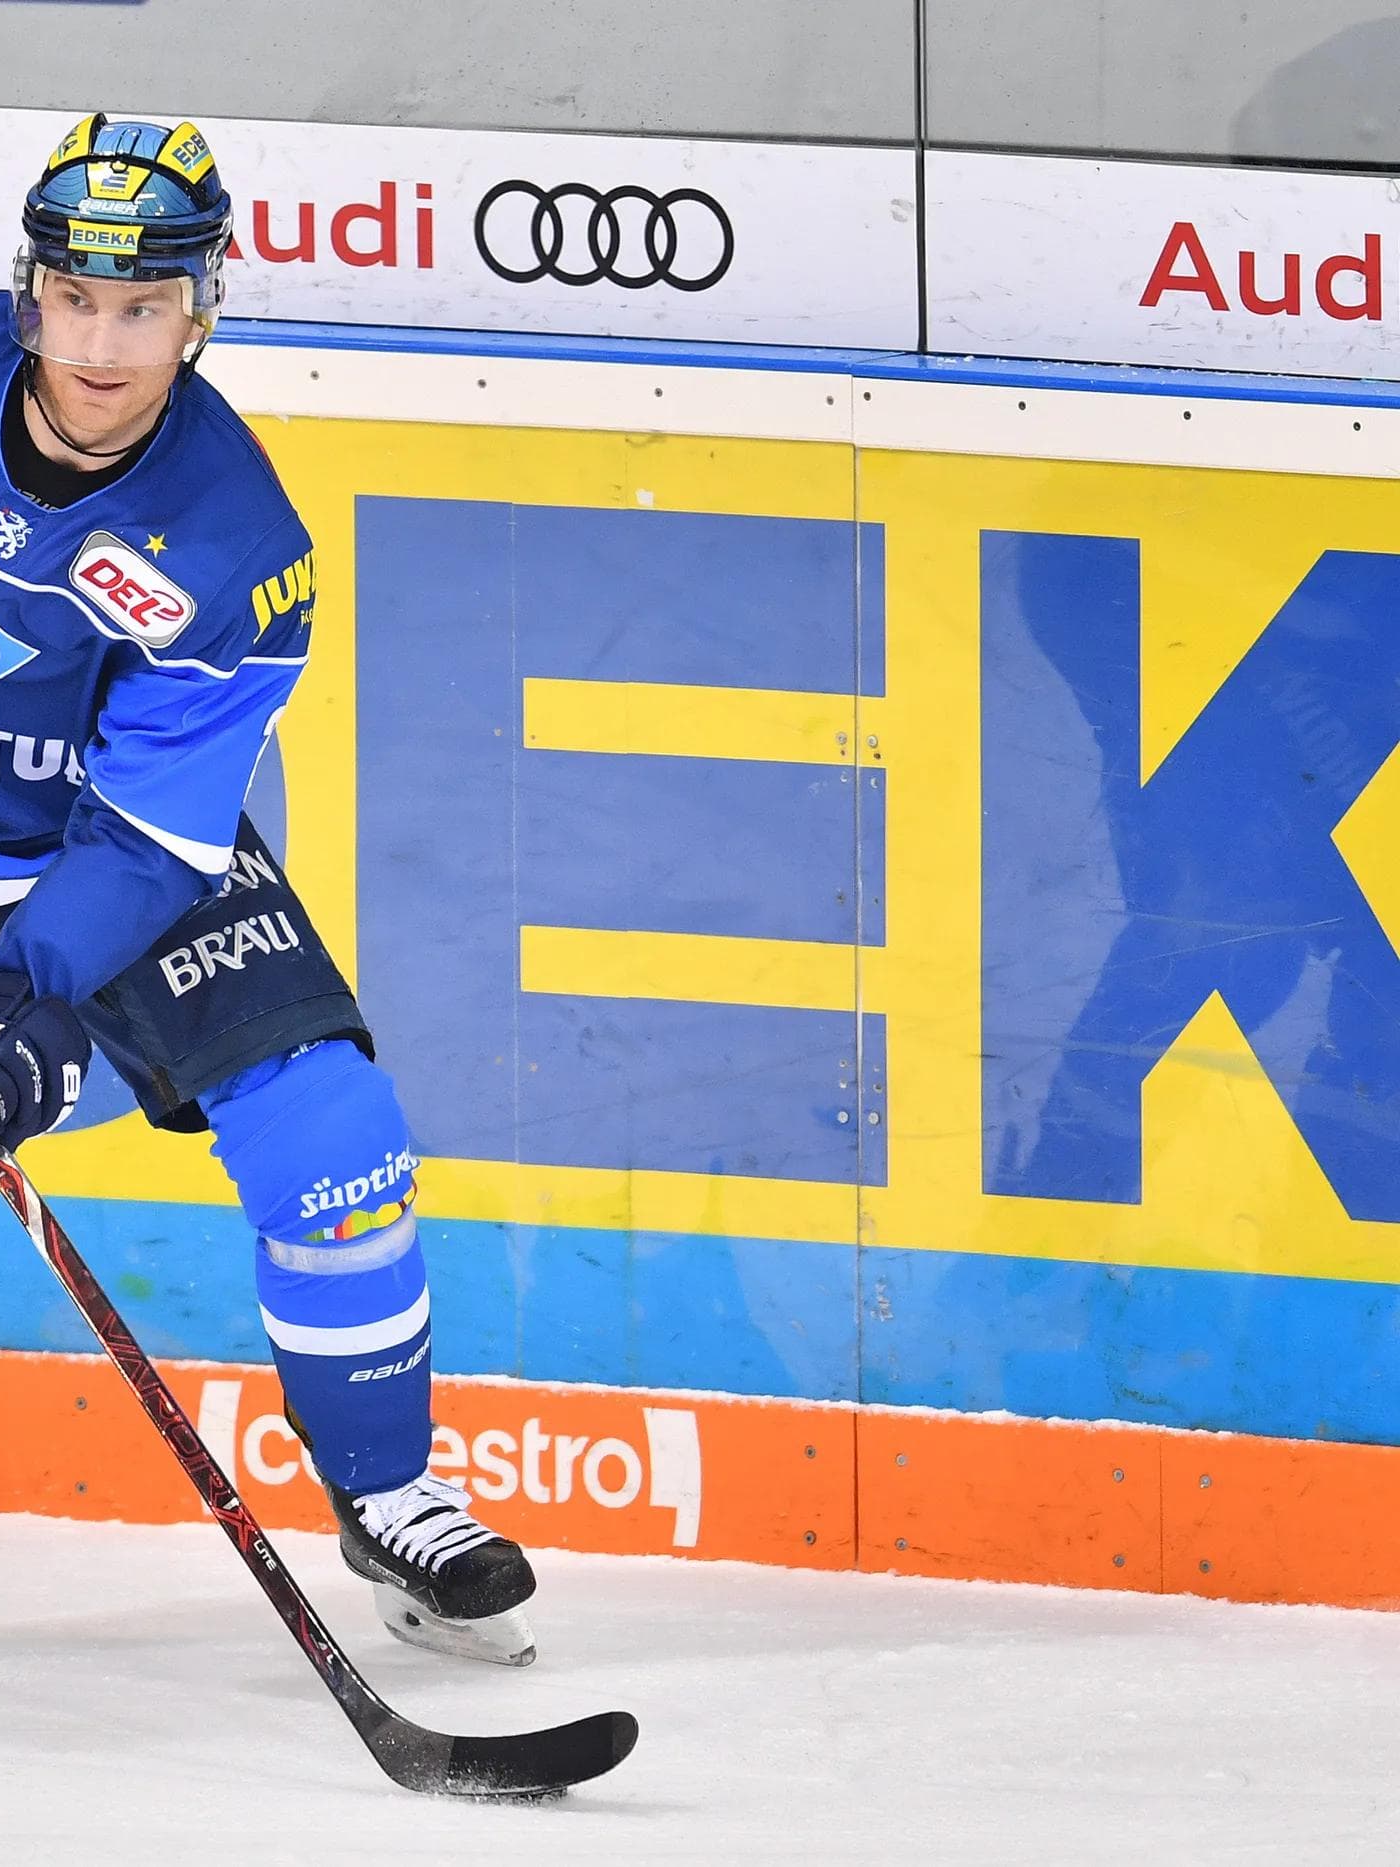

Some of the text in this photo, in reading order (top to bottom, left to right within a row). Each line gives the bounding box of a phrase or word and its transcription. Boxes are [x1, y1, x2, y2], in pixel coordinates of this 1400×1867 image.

[72, 228, 136, 246] EDEKA
[225, 181, 434, 269] udi
[158, 910, 300, 998] BRÄU
[241, 1413, 643, 1509] cestro
